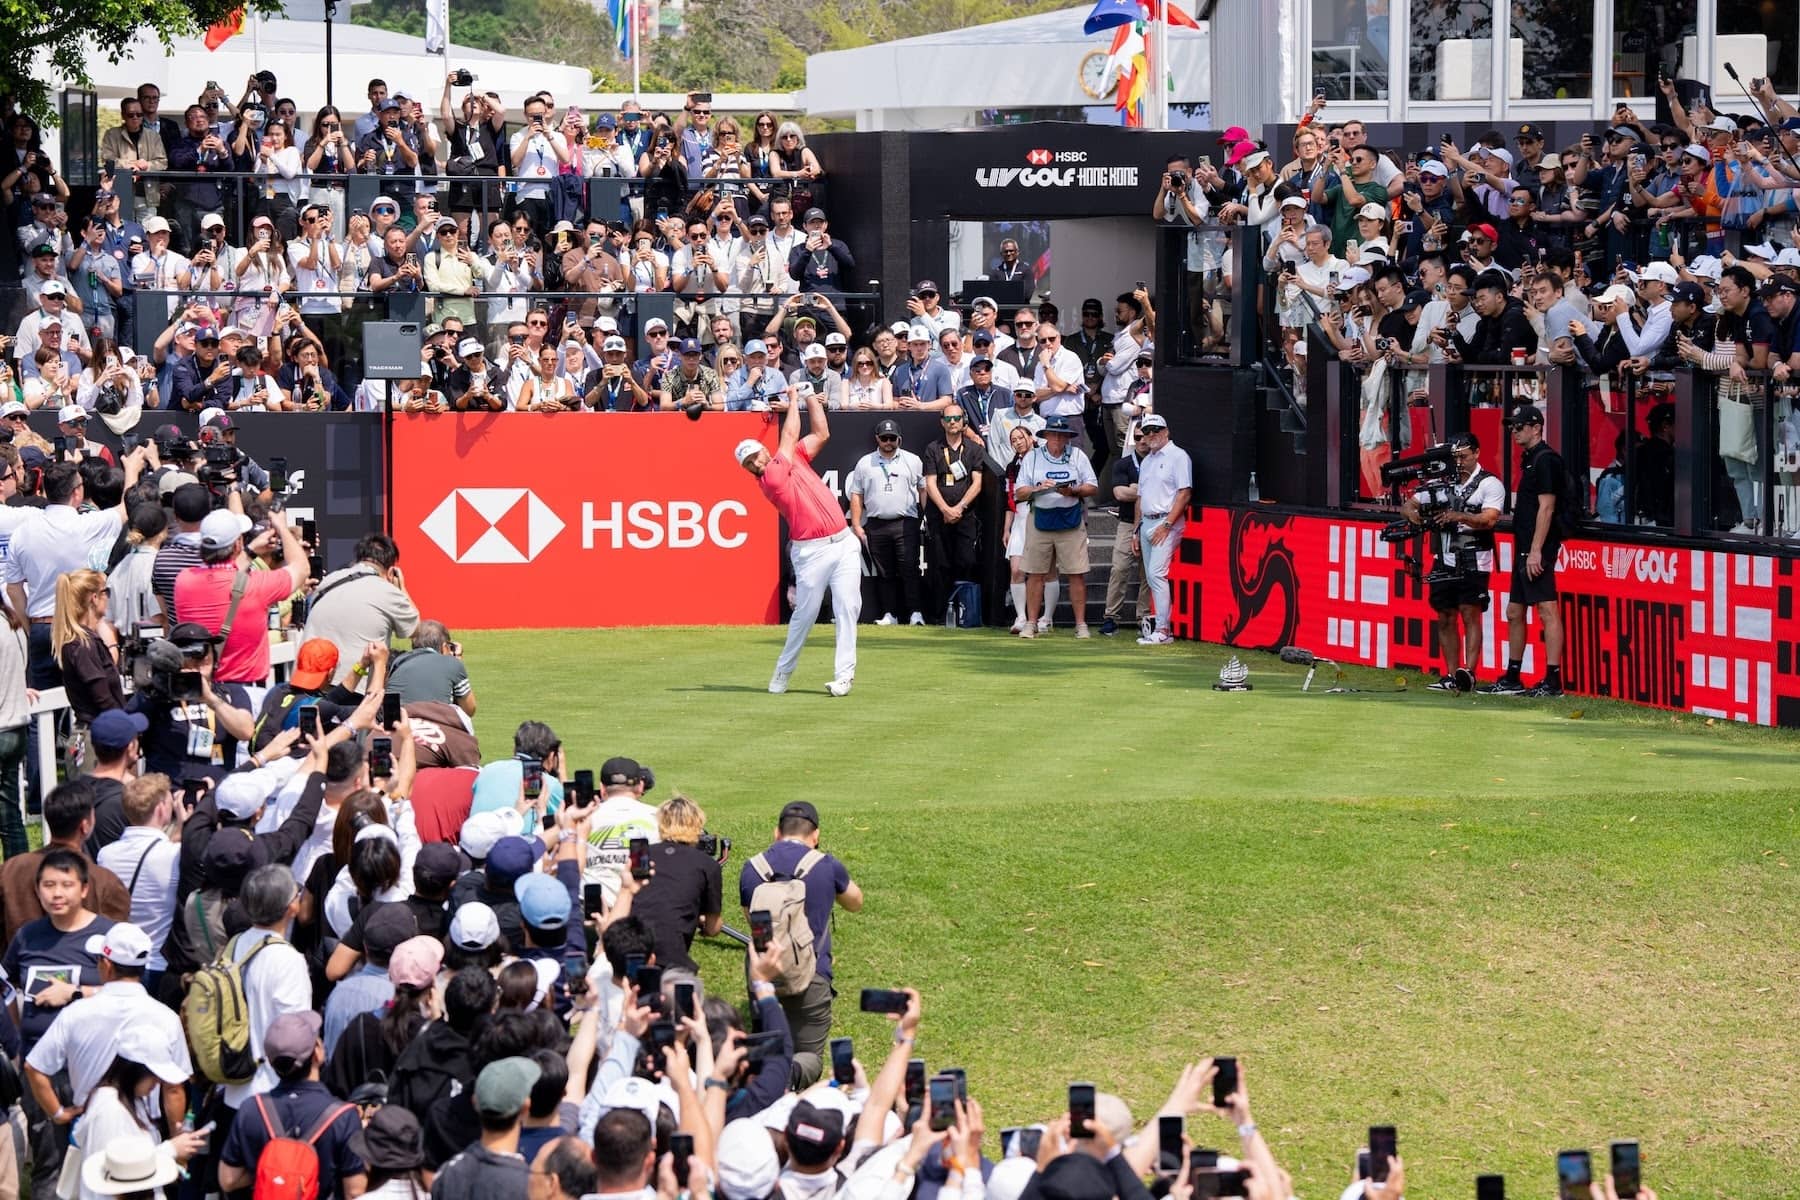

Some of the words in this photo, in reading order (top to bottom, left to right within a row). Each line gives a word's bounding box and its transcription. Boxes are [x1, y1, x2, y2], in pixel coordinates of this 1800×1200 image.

[1055, 151, 1088, 163] HSBC
[1019, 167, 1077, 188] GOLF
[1077, 167, 1109, 187] HONG
[1109, 167, 1139, 187] KONG
[582, 500, 748, 549] HSBC
[1570, 549, 1597, 571] HSBC
[1635, 548, 1678, 584] GOLF
[1557, 591, 1612, 696] ONG
[1615, 598, 1686, 708] KONG
